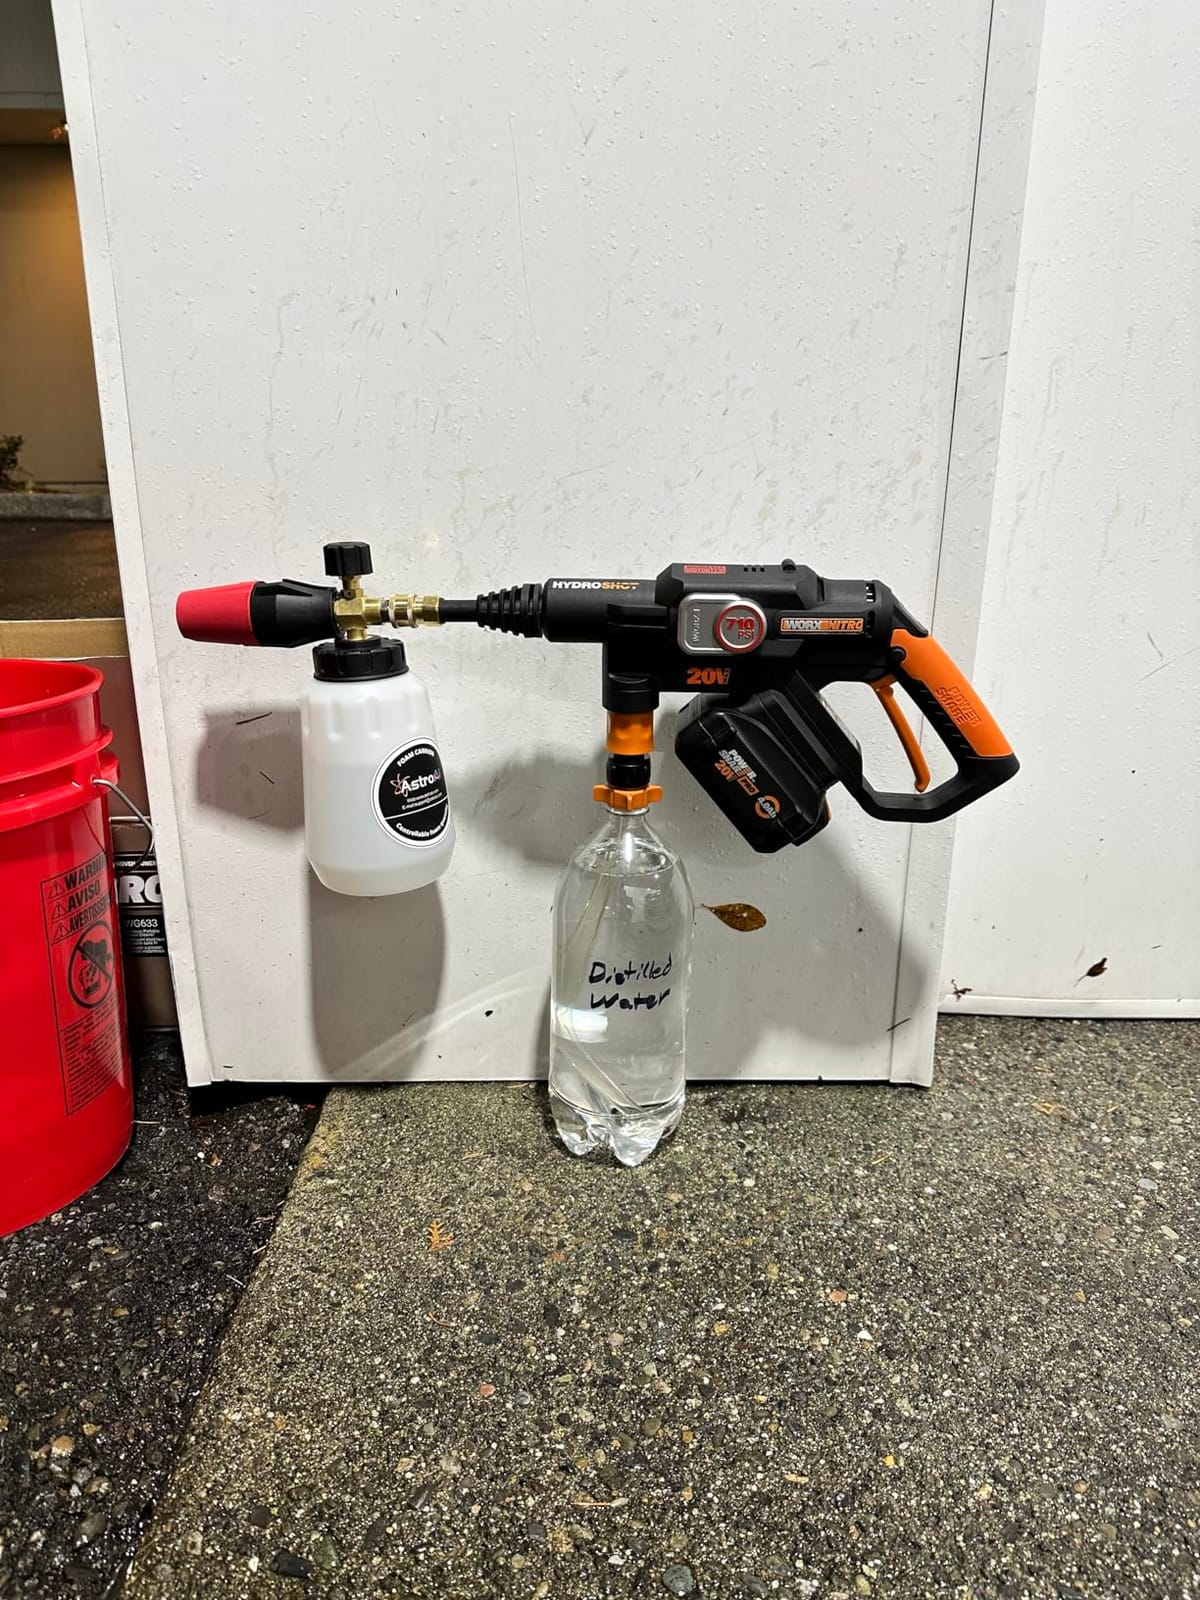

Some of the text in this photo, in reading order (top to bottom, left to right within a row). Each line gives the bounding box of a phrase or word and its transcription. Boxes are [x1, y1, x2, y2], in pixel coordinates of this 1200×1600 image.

[552, 581, 640, 590] HYDROSHOT
[726, 616, 755, 631] 710
[738, 629, 755, 639] PSI
[787, 620, 863, 630] WORX NITRO
[687, 668, 731, 685] 20V
[935, 687, 967, 725] SHARE
[948, 686, 981, 727] POWER
[714, 760, 757, 794] 20V PRO
[728, 749, 757, 782] POWER
[67, 880, 101, 912] AVISO
[589, 952, 672, 985] Distilled
[590, 988, 671, 1010] Water
